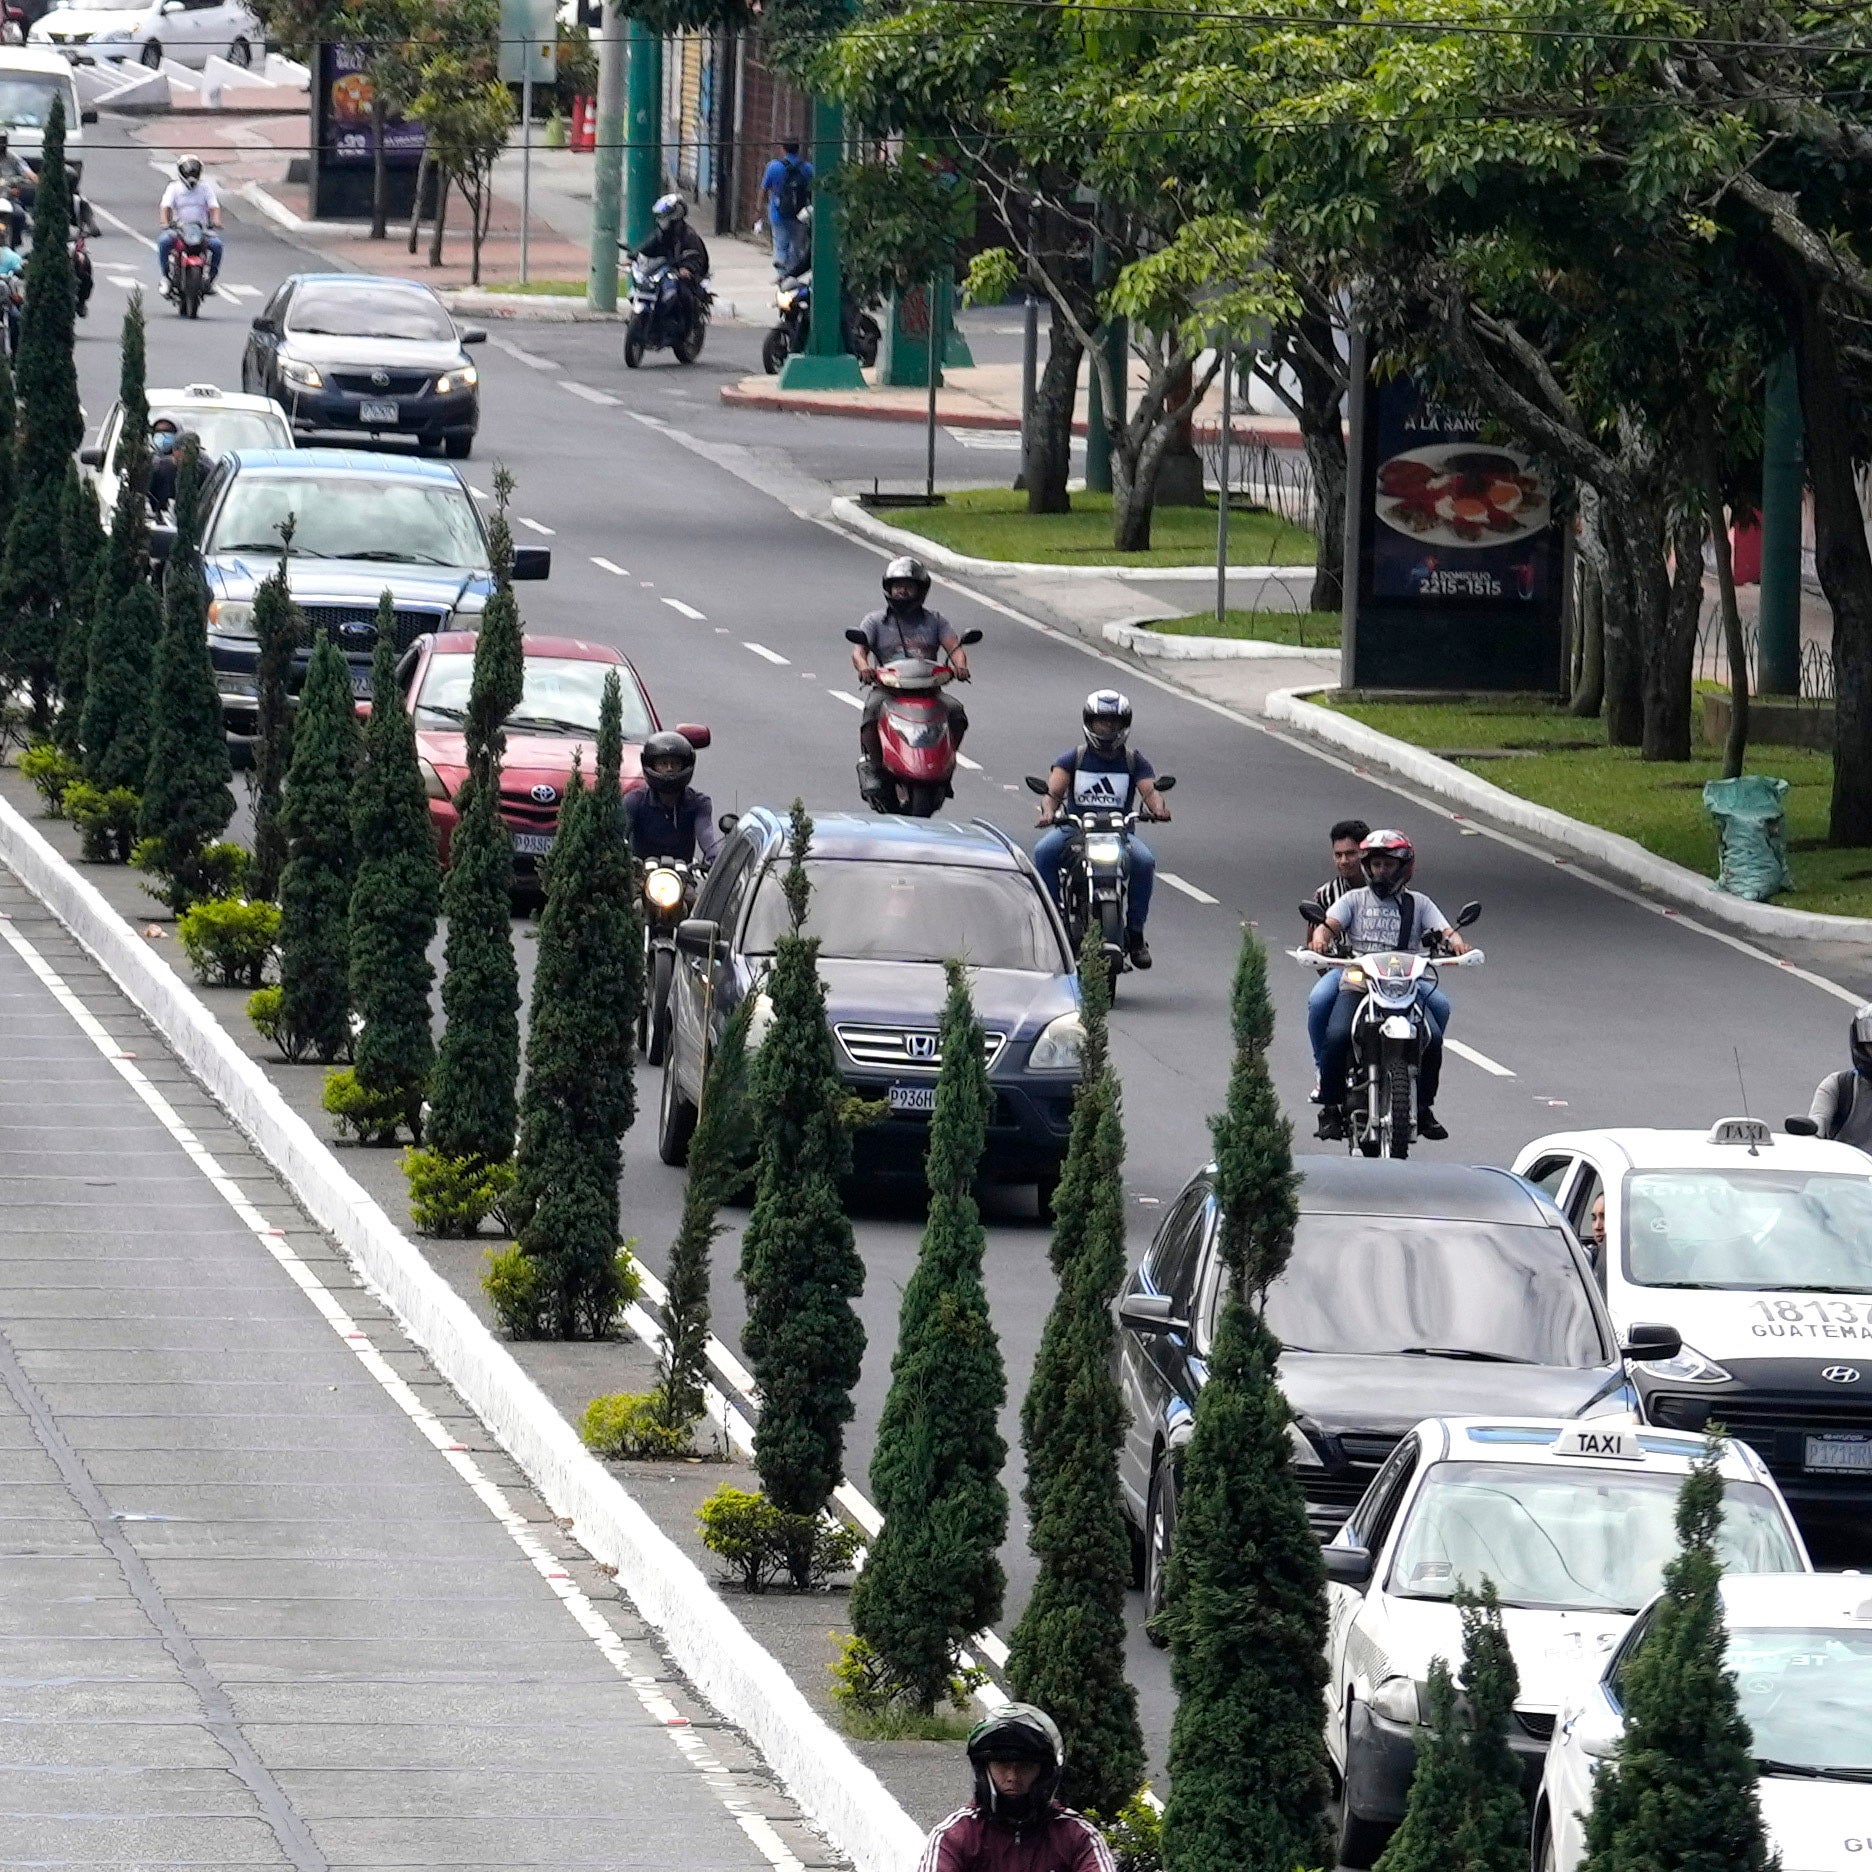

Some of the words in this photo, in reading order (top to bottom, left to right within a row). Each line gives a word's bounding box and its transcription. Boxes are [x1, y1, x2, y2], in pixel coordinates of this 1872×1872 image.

[1420, 579, 1501, 596] 2215-1515
[1722, 1125, 1762, 1139] TAXI
[1578, 1434, 1621, 1453] TAXI
